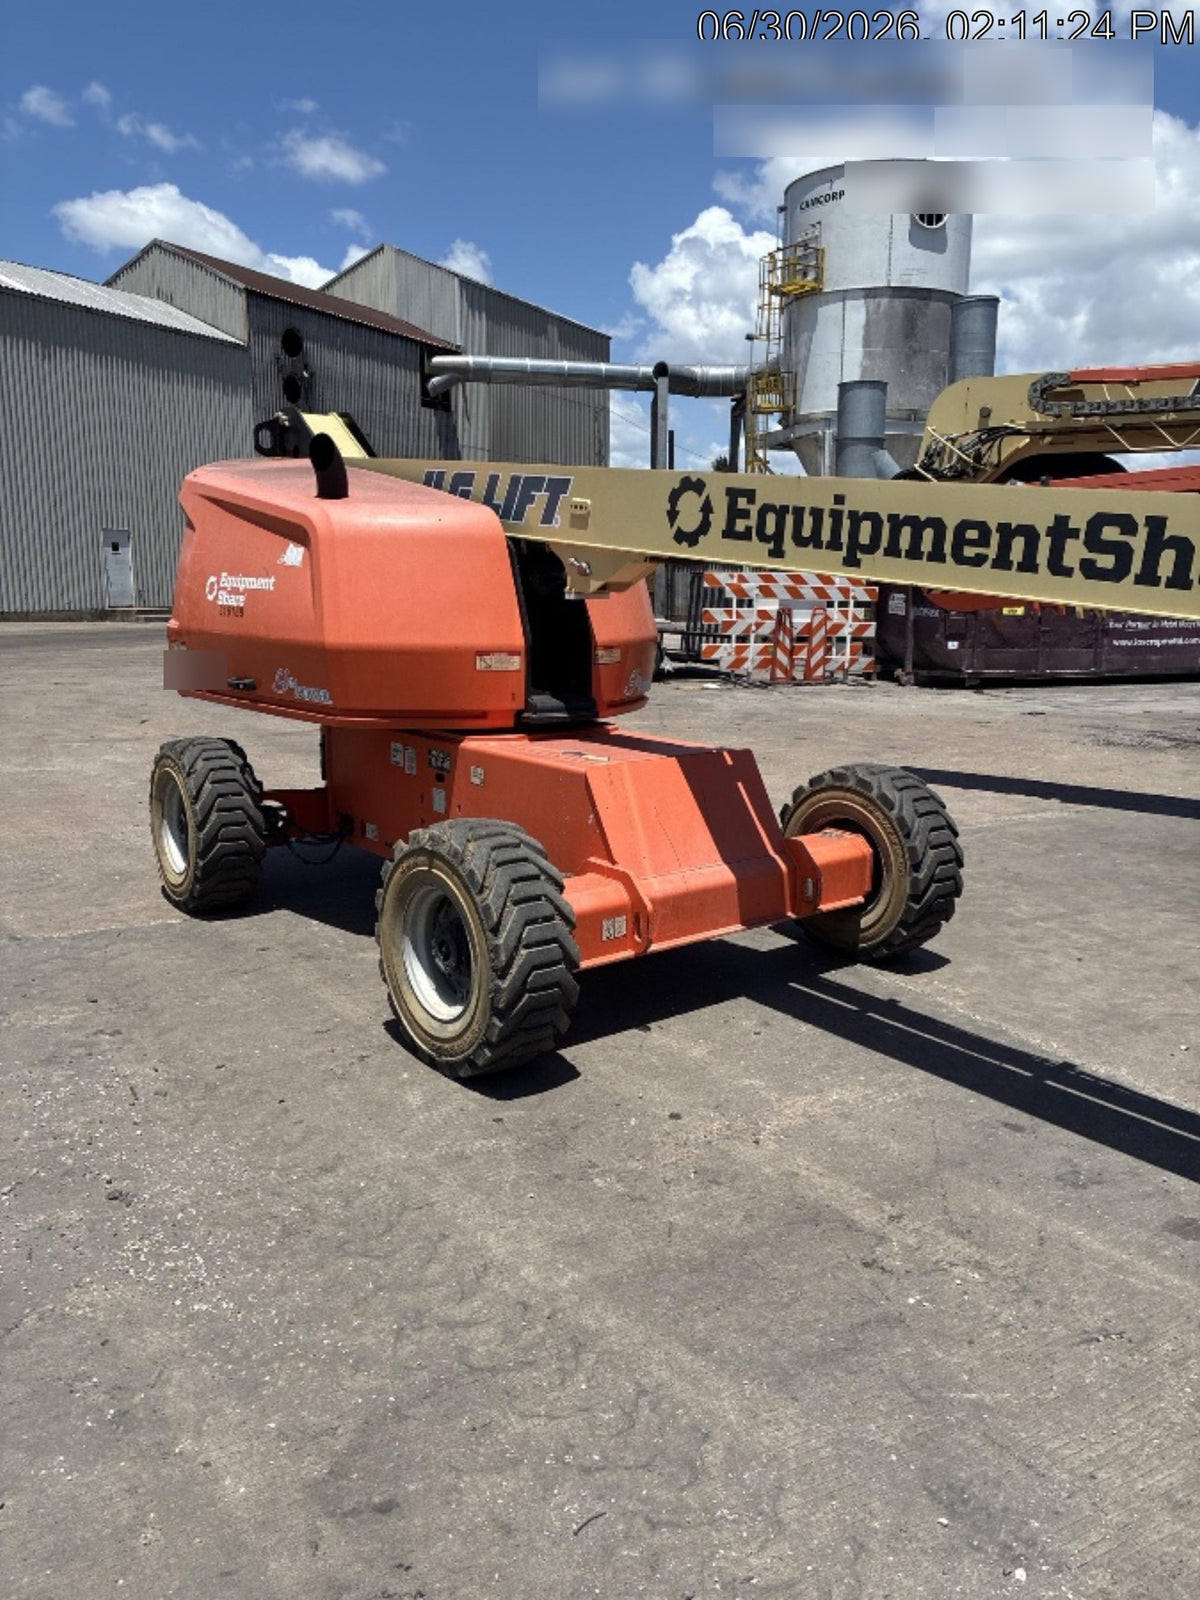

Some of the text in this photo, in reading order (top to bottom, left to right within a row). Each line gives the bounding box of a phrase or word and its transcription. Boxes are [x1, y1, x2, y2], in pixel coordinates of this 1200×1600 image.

[482, 472, 574, 526] LIFT
[721, 486, 1200, 591] EquipmentSh
[217, 590, 246, 606] Share
[220, 572, 275, 591] Equipment
